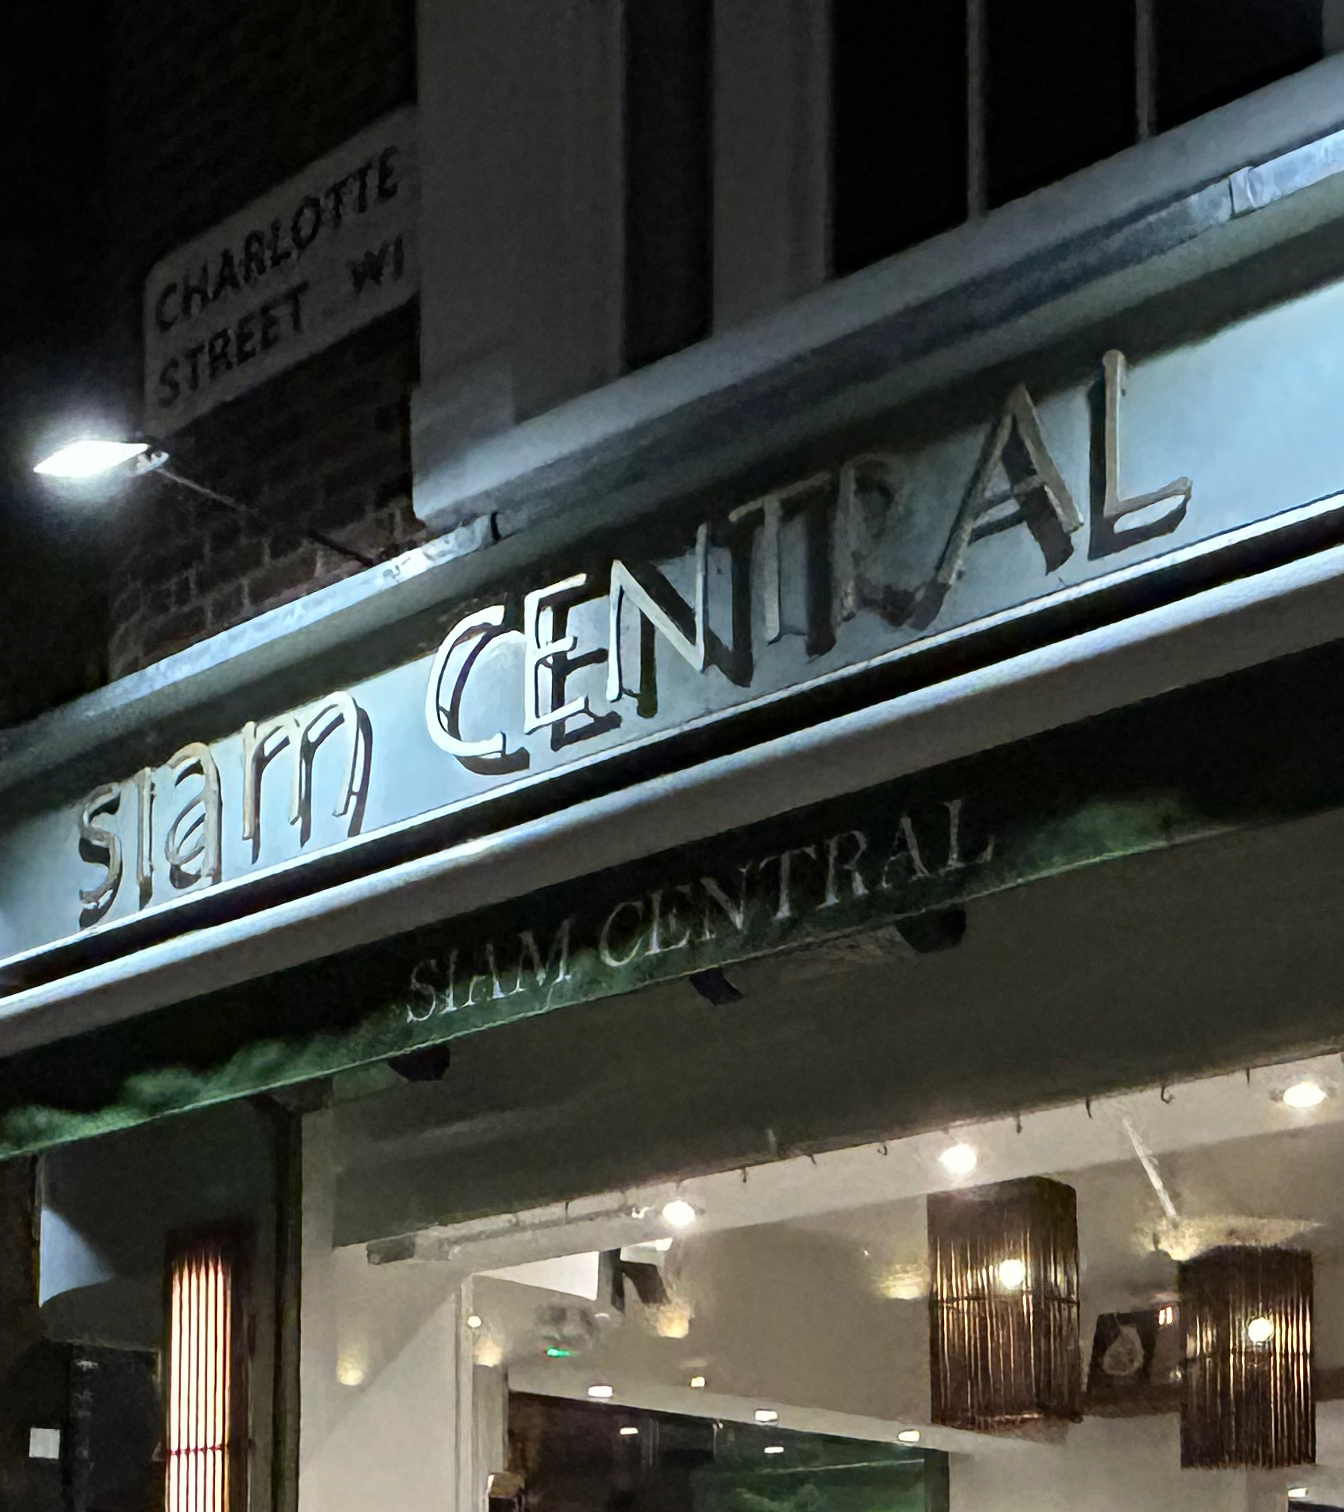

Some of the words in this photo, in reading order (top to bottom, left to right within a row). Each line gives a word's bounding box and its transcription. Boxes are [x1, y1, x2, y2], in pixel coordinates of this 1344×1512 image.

[156, 145, 399, 333] CHARLOTTE
[158, 280, 310, 408] STREET
[425, 350, 1193, 760] CENTRAL
[407, 917, 572, 1024] SIAM
[600, 801, 995, 968] CENTRAL
